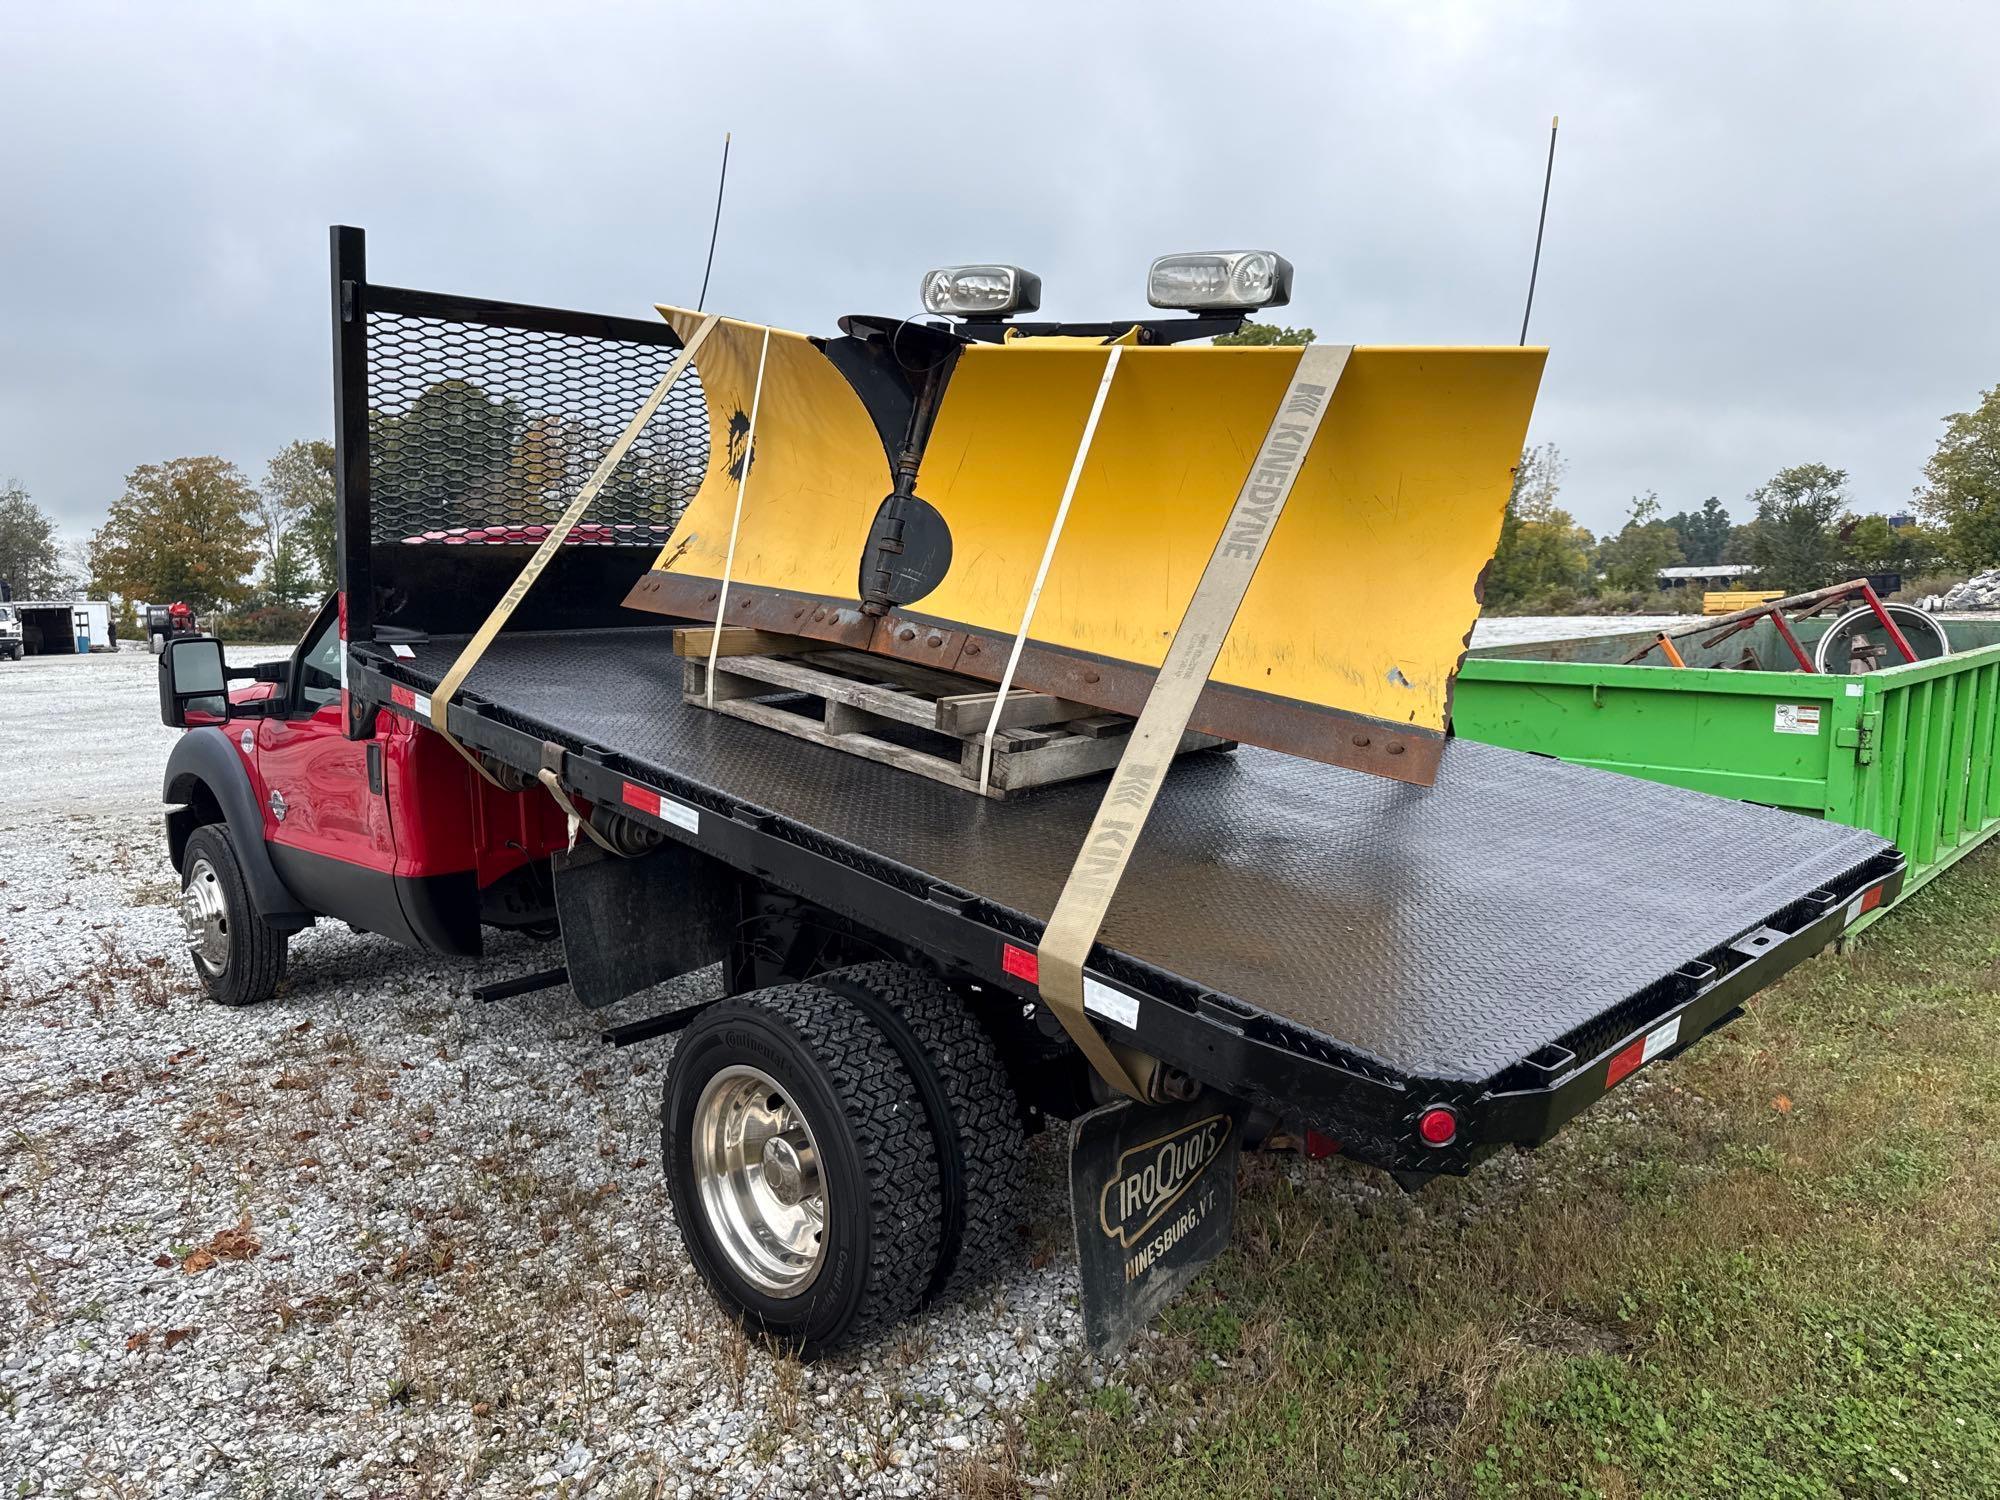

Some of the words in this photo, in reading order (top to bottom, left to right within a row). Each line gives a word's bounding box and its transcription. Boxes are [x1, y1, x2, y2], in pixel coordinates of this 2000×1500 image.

[1222, 423, 1309, 560] KINEDYNE
[500, 496, 590, 612] KINEDYNE
[1120, 1122, 1218, 1221] IROQUOIS
